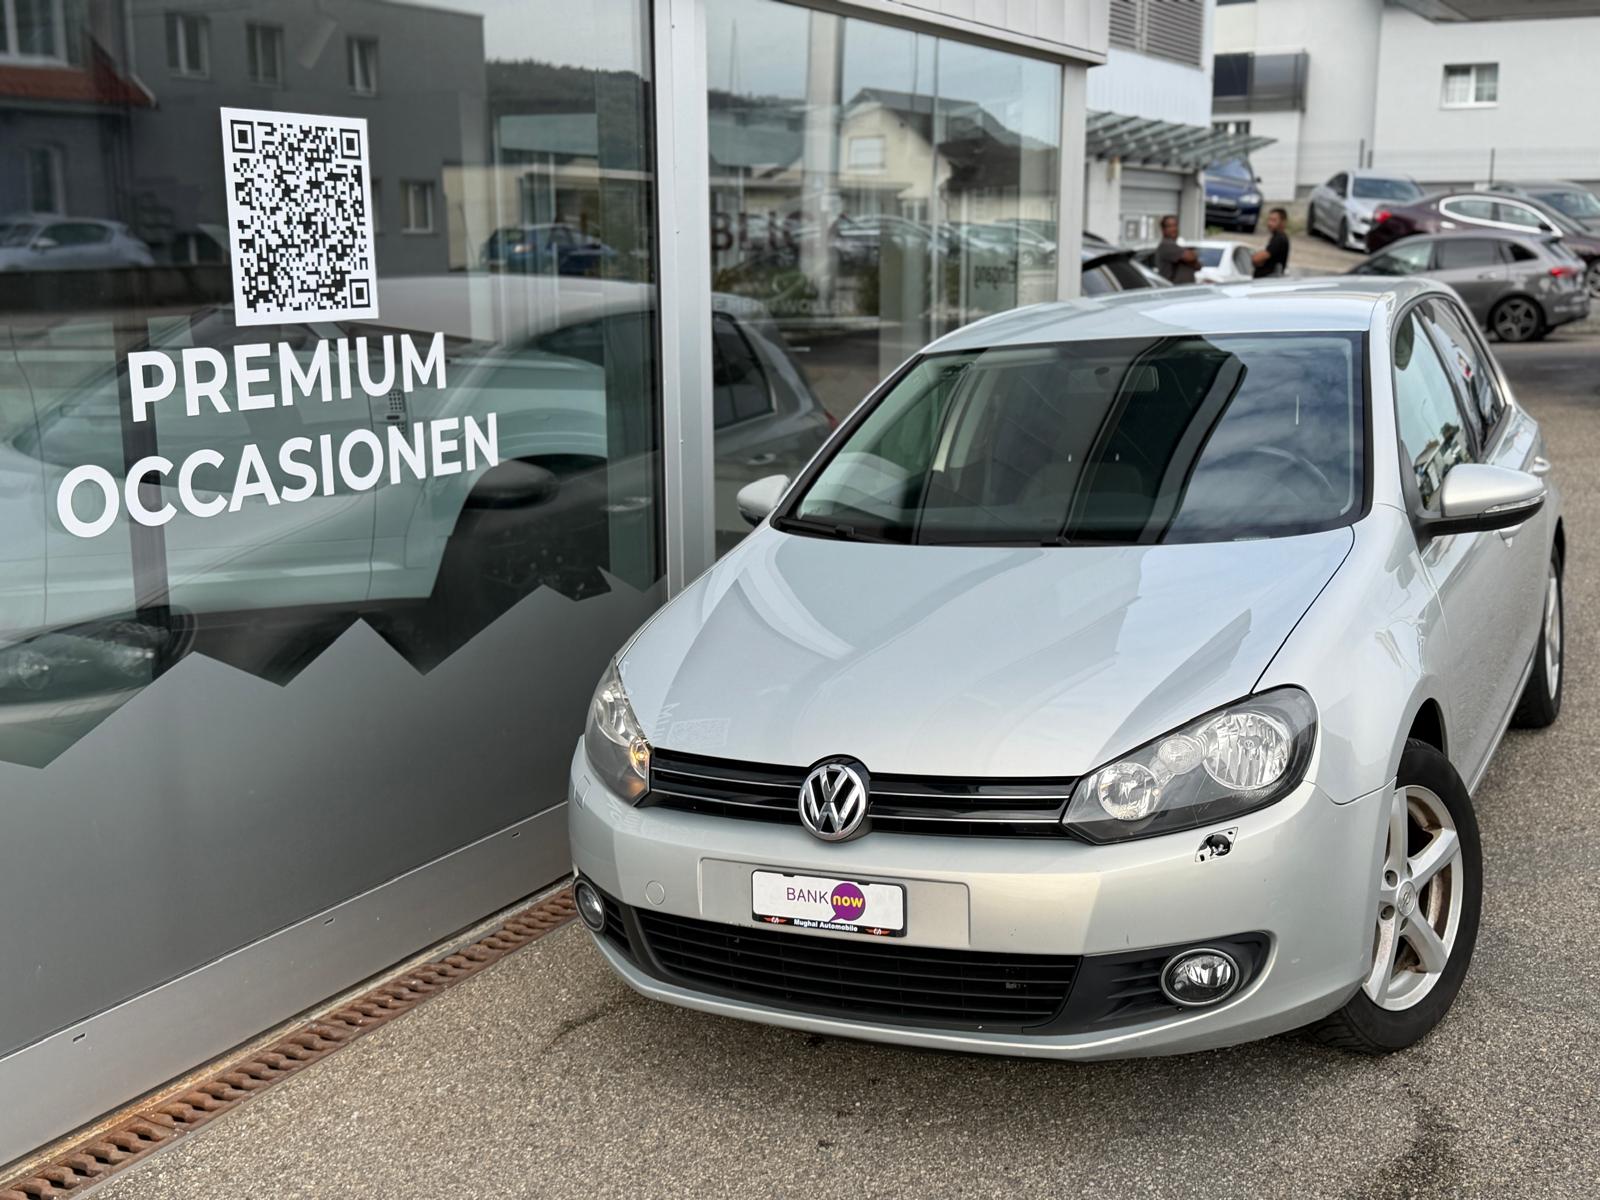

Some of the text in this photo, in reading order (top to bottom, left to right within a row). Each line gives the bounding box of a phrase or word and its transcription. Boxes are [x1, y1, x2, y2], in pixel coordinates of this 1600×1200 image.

[128, 332, 446, 422] PREMIUM
[57, 412, 499, 537] OCCASIONEN
[786, 887, 863, 909] BANK now
[793, 919, 818, 929] Mughal
[819, 920, 858, 932] Automobile
